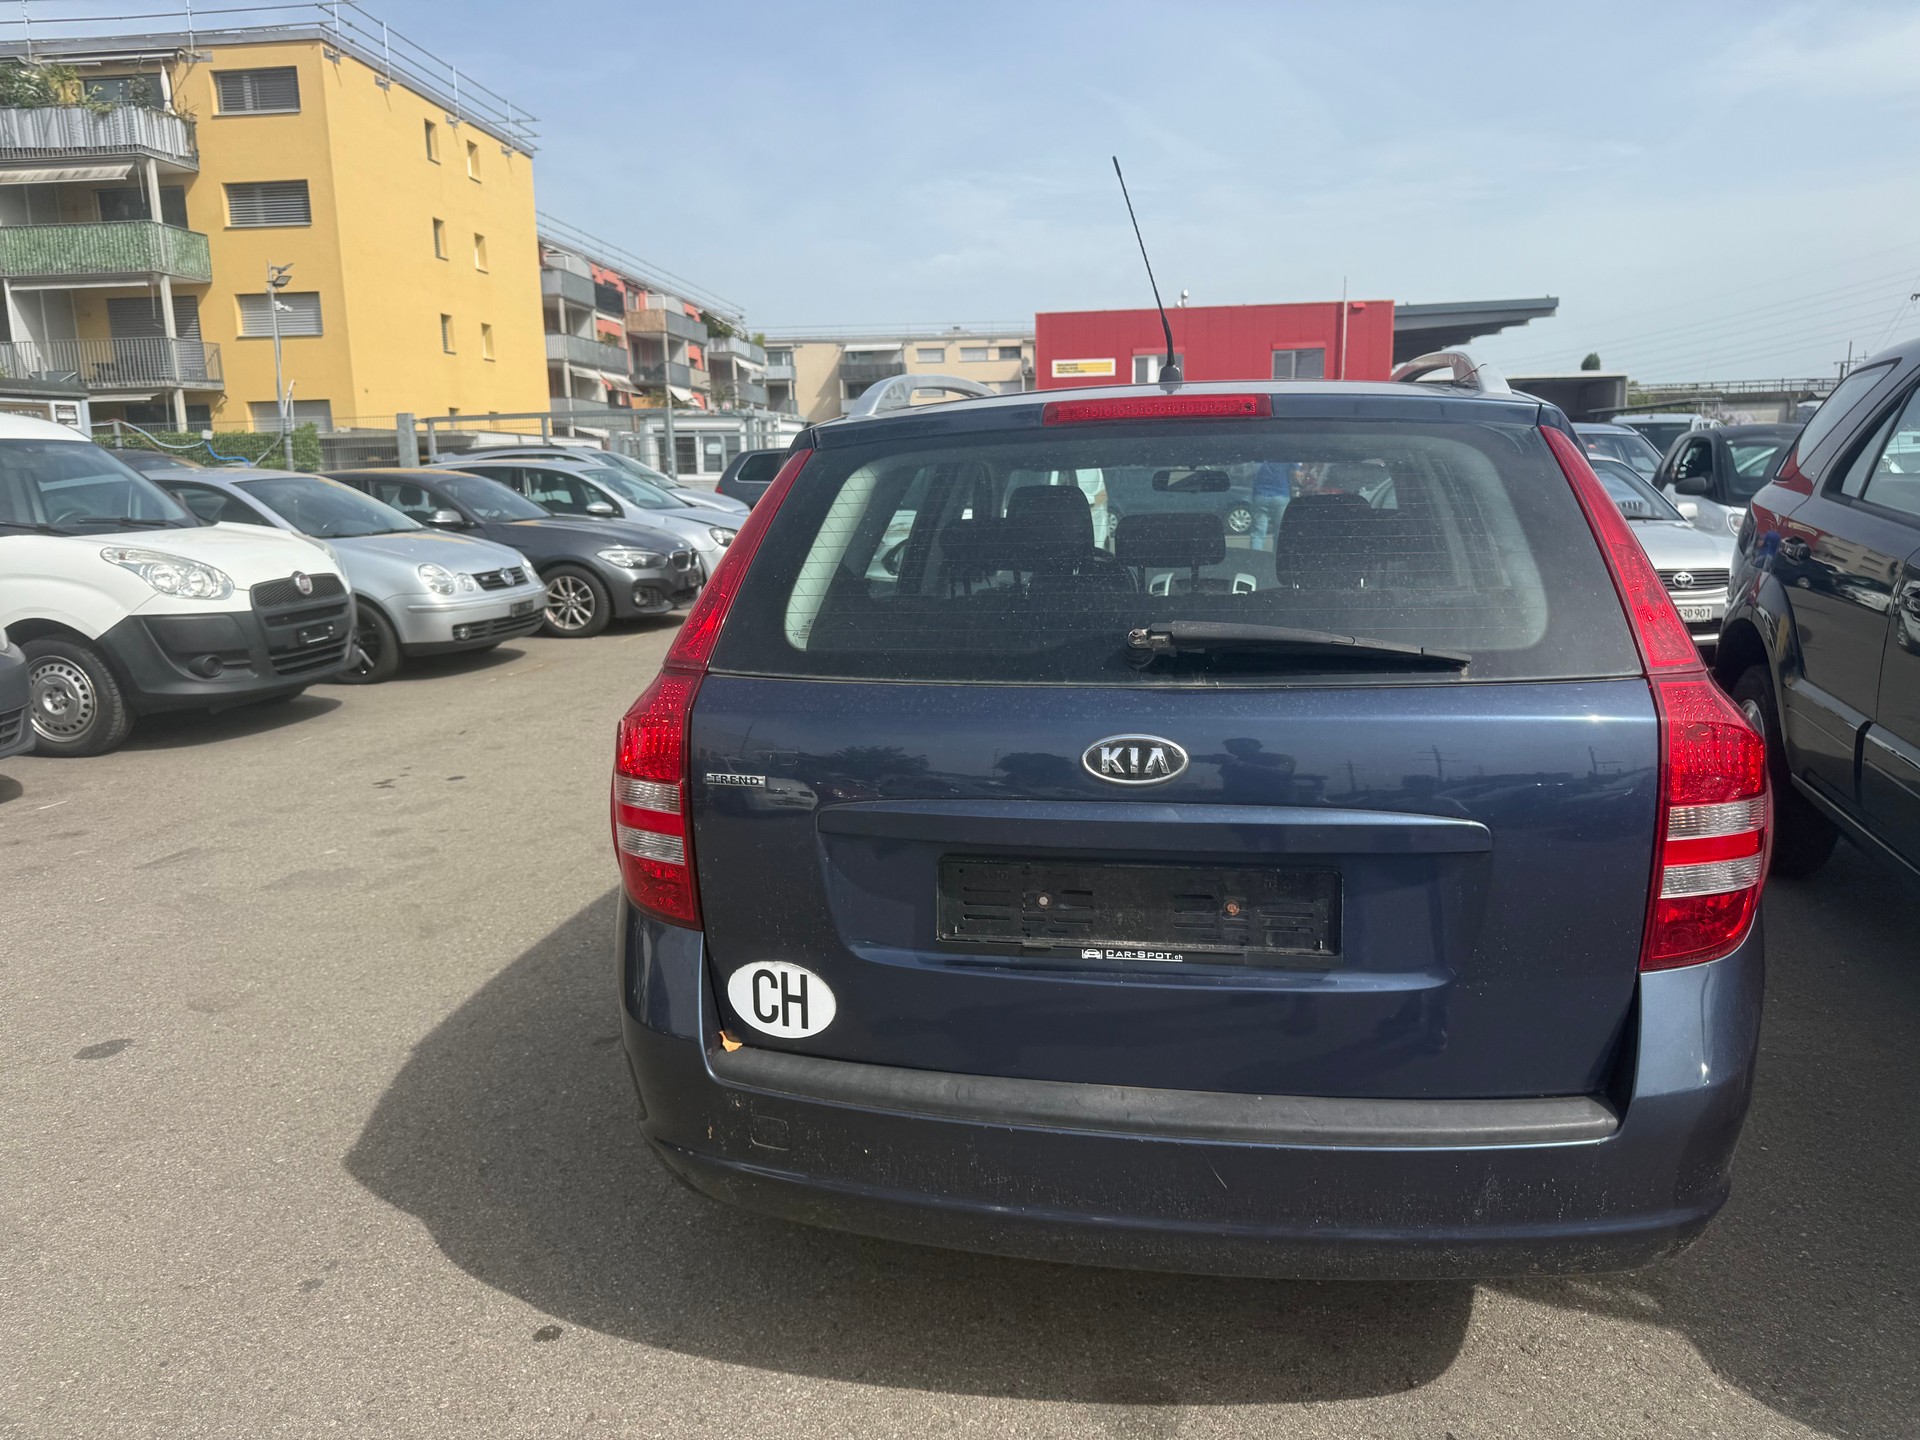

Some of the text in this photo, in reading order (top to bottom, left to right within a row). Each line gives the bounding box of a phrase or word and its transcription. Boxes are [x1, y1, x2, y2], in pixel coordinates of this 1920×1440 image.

[1100, 747, 1171, 774] KIA
[711, 774, 759, 786] TREND
[752, 969, 809, 1030] CH
